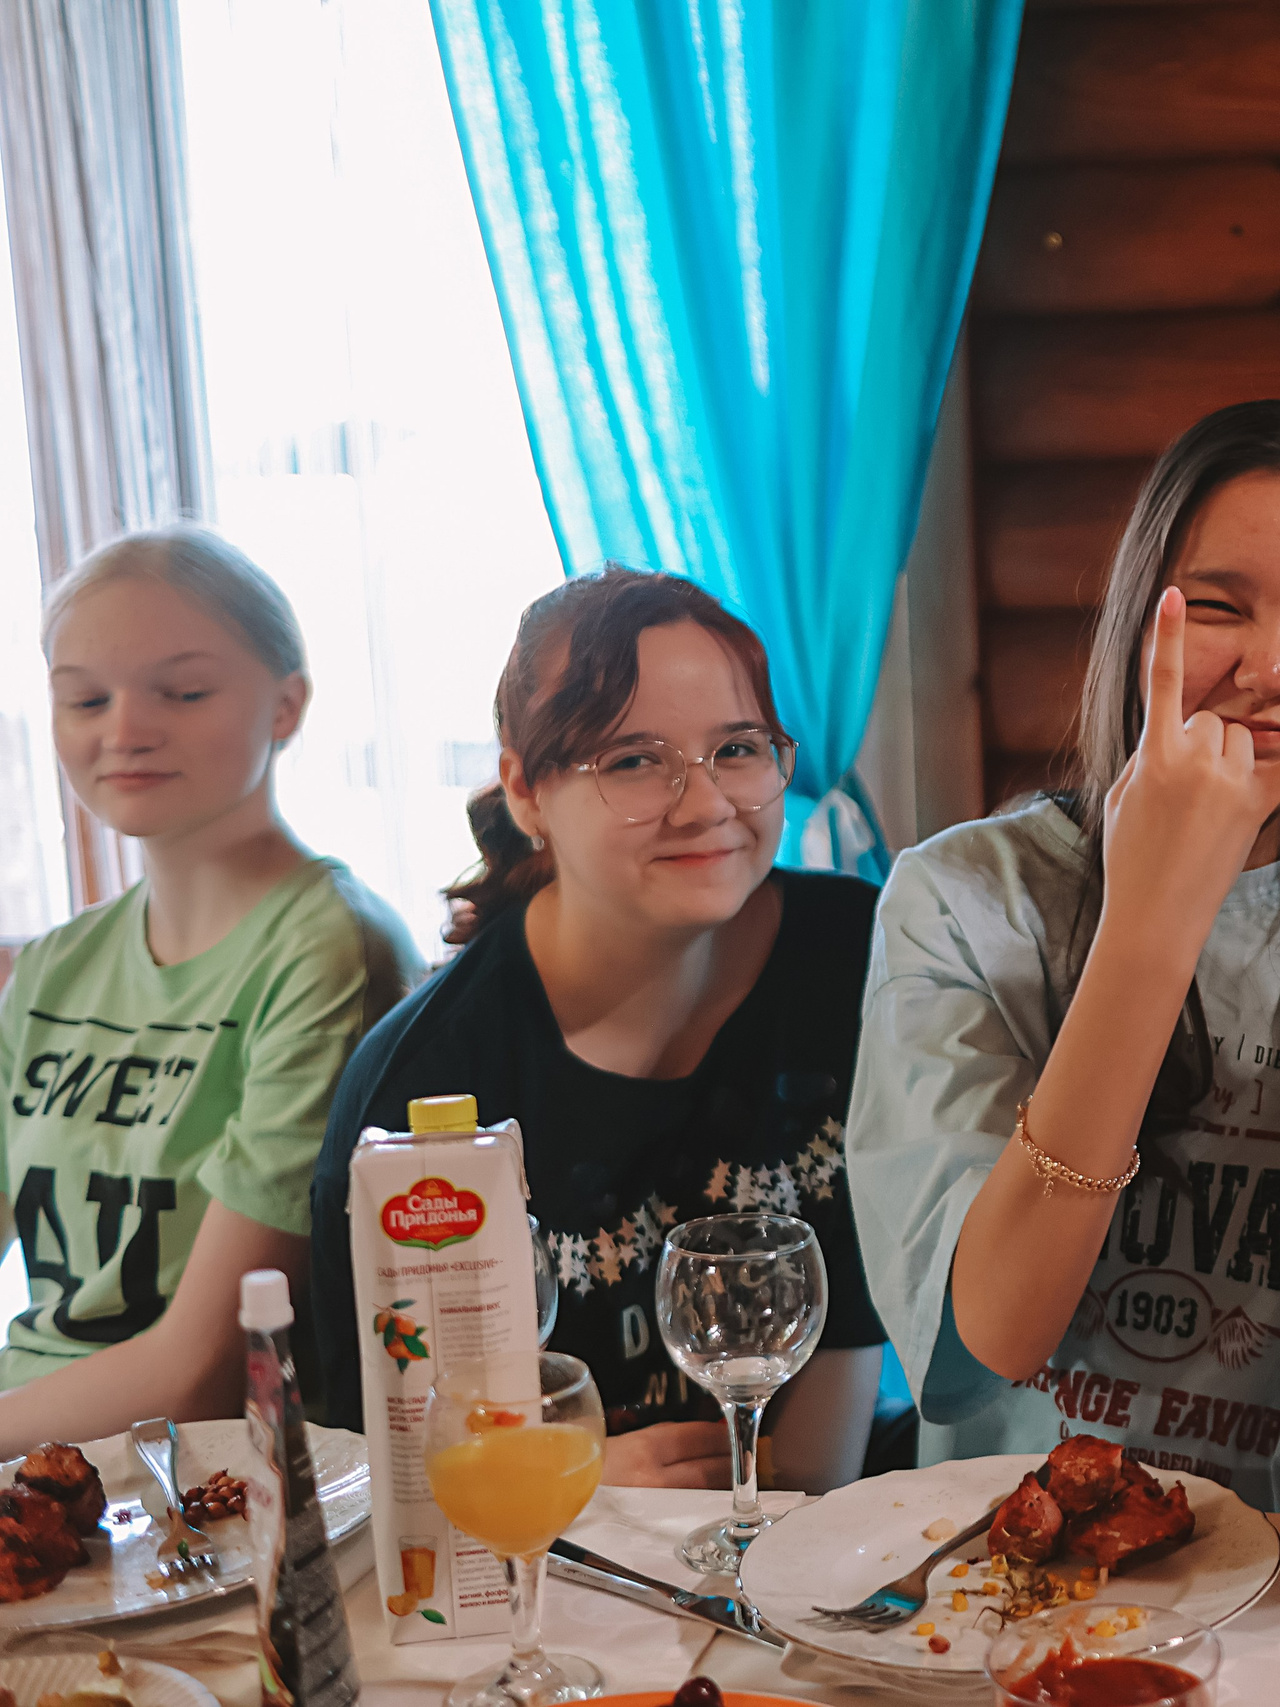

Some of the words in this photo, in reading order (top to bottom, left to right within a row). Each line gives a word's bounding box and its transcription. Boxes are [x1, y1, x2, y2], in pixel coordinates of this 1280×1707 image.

[406, 1194, 459, 1213] Сады
[389, 1208, 478, 1231] Придонья
[1115, 1289, 1199, 1338] 1903
